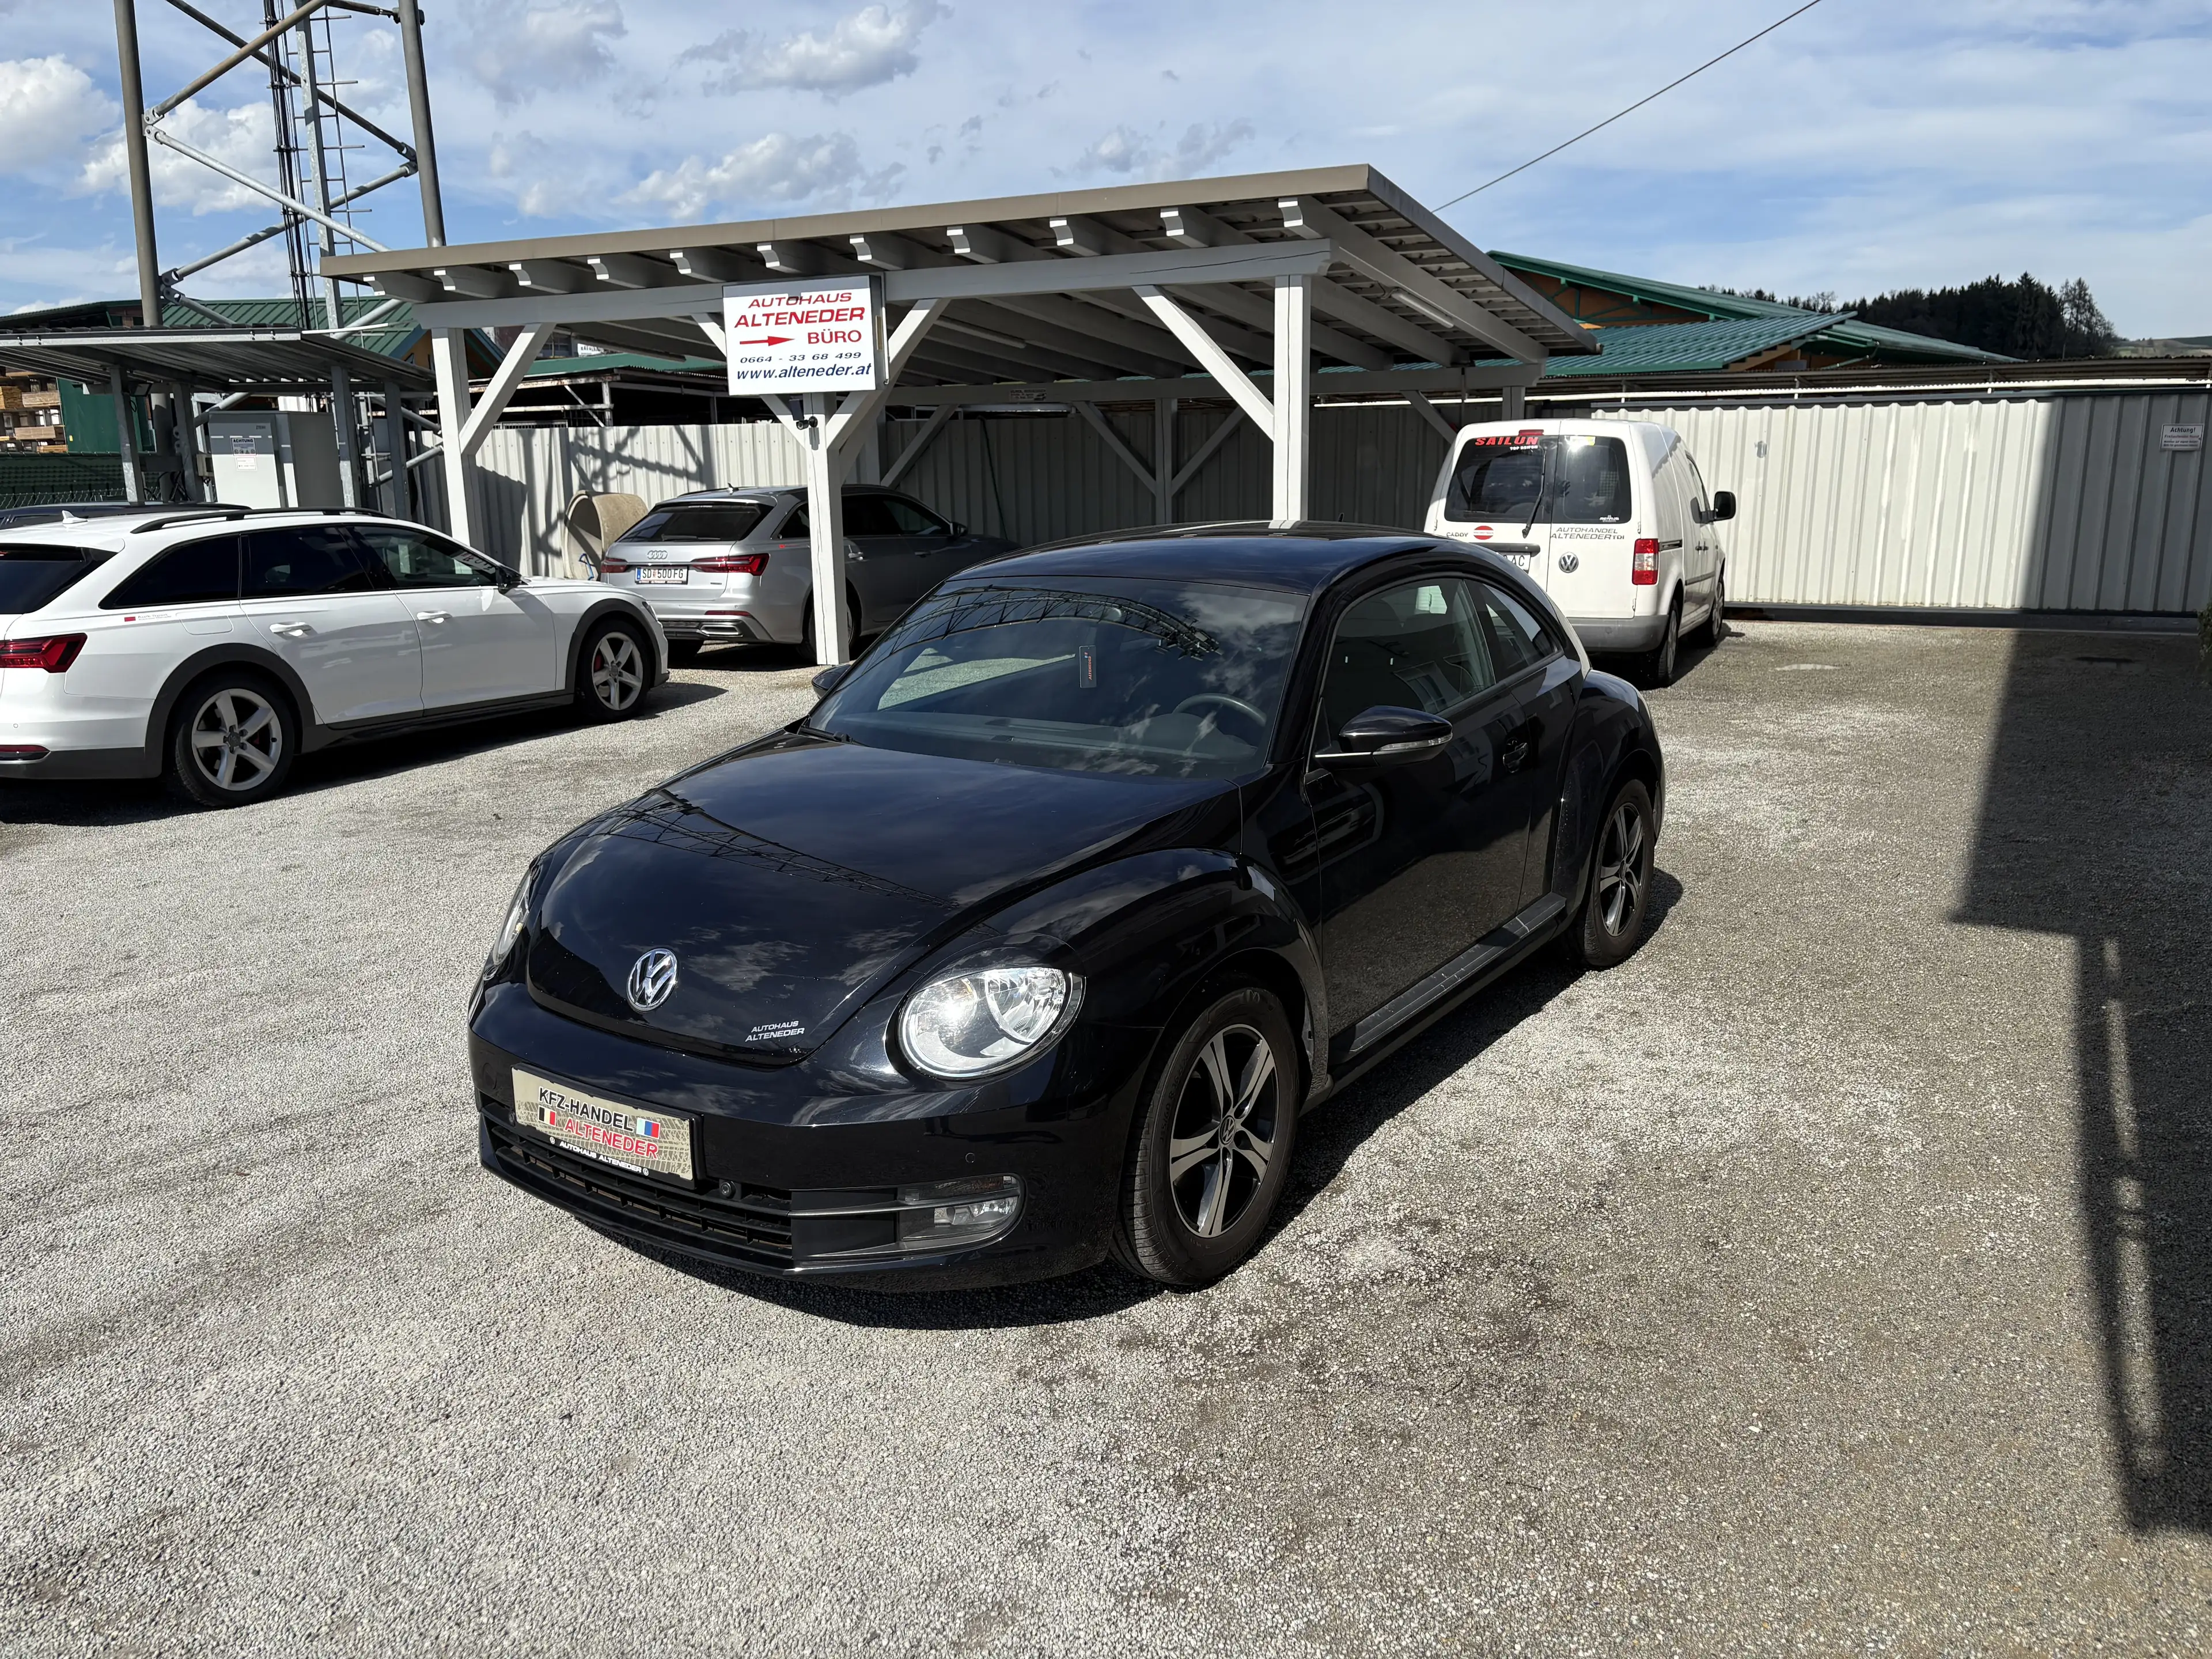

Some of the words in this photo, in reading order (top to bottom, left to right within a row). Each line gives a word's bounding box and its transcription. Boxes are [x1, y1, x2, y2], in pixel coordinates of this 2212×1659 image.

[748, 292, 852, 309] AUTOHAUS
[734, 307, 865, 328] ALTENEDER
[808, 329, 862, 344] BÜRO
[737, 363, 872, 380] www.alteneder.at
[1475, 437, 1539, 446] SAILUN
[642, 569, 652, 578] SD
[657, 569, 672, 578] 500
[673, 569, 684, 578] FG
[745, 1027, 805, 1043] ALTENEDER
[751, 1020, 800, 1033] AUTOHAUS
[539, 1086, 635, 1133] KFZ-HANDEL
[563, 1118, 660, 1160] ALTENEDER
[559, 1141, 597, 1159] AUTOHAUS
[598, 1154, 642, 1174] ALTENEDER
